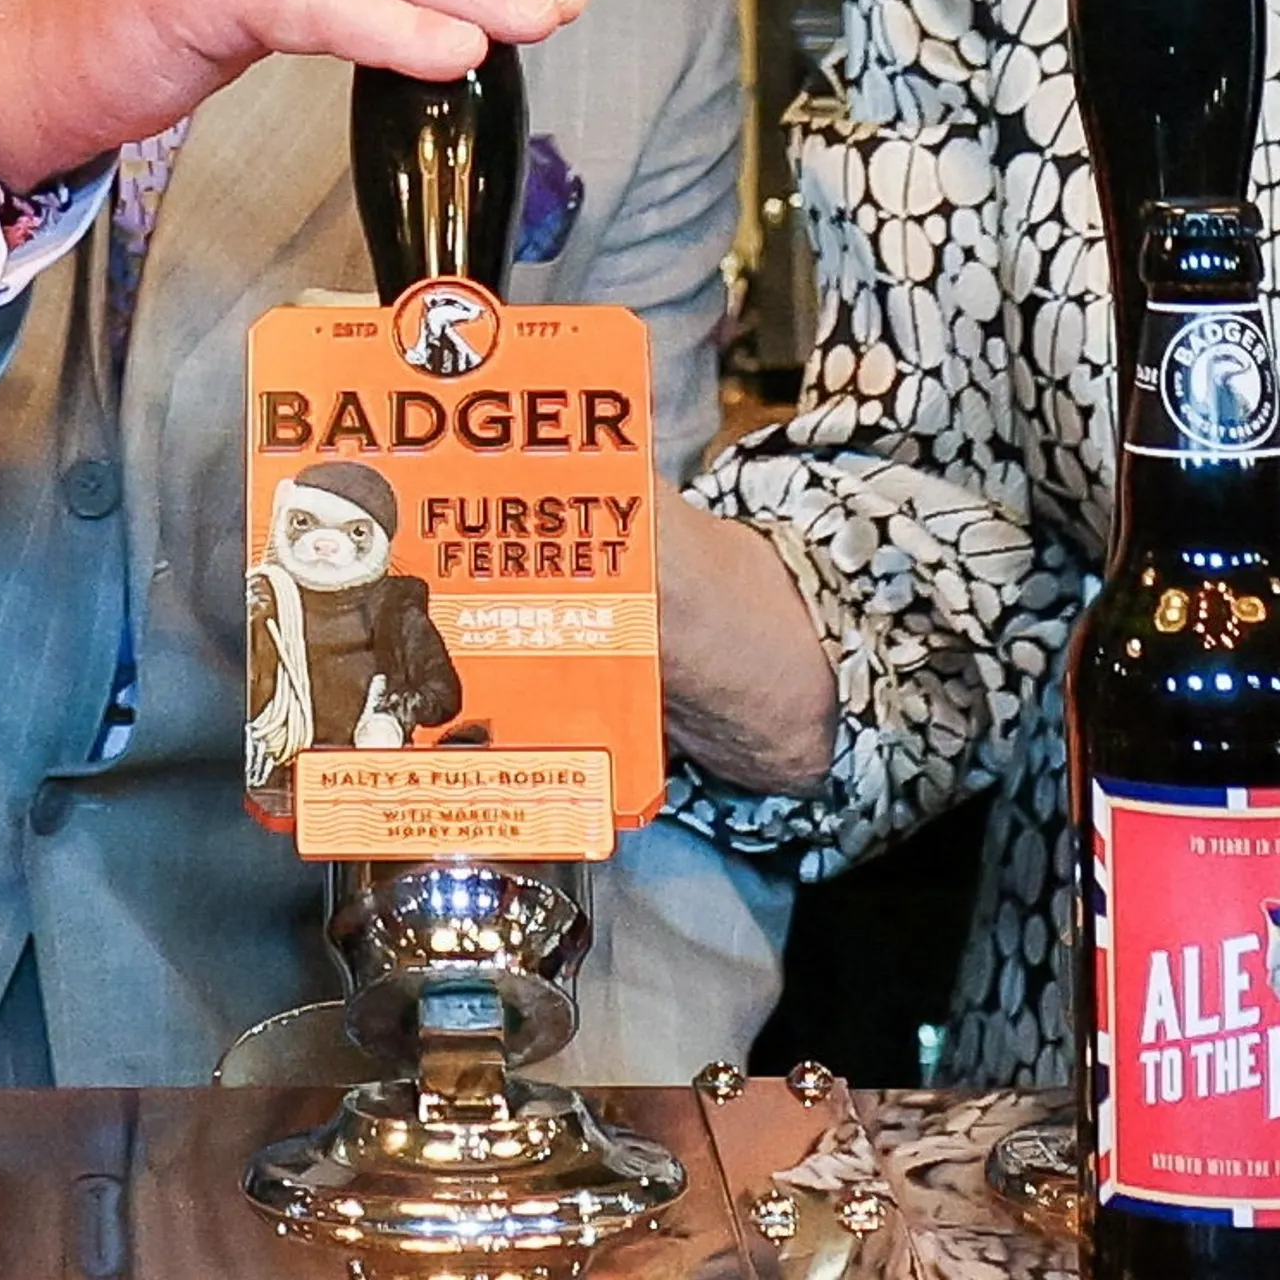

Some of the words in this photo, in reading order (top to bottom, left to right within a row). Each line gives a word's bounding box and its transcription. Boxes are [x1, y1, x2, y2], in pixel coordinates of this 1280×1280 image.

[516, 322, 561, 338] 1777
[1174, 320, 1267, 368] BADGER
[259, 389, 637, 453] BADGER
[421, 496, 642, 539] FURSTY
[438, 540, 627, 579] FERRET
[456, 607, 554, 628] AMBER
[562, 607, 613, 628] ALE
[321, 771, 398, 788] MALTY
[407, 771, 420, 787] &
[430, 770, 587, 787] FULL-BODIED
[1139, 933, 1263, 1045] ALE
[1138, 1045, 1184, 1106] TO
[1190, 1030, 1263, 1099] THE
